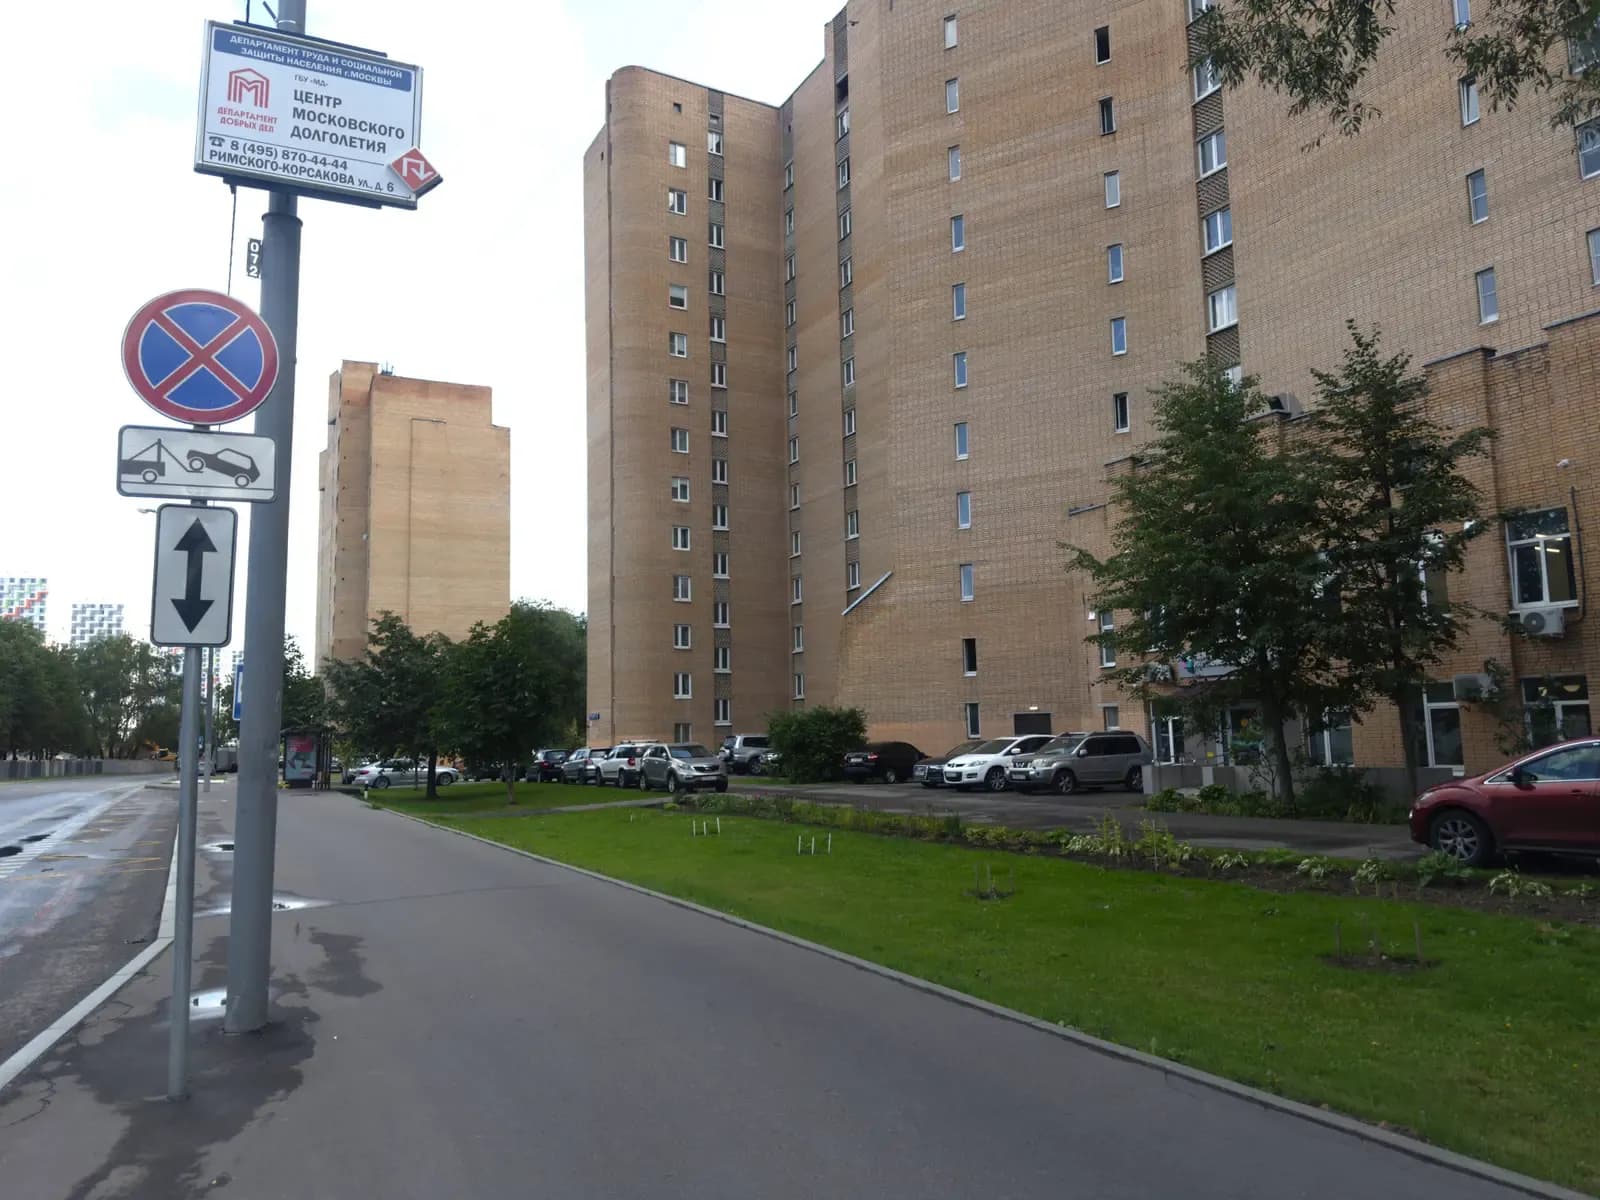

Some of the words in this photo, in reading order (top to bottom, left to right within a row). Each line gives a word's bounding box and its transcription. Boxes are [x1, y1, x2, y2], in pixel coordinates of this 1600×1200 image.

[230, 35, 298, 56] ДЕПАРТАМЕНТ
[302, 50, 330, 64] ТРУДА
[332, 57, 339, 65] И
[341, 58, 403, 79] СОЦИАЛЬНОЙ
[241, 47, 284, 62] ЗАЩИТЫ
[286, 56, 342, 76] НАСЕЛЕНИЯ
[293, 89, 342, 109] ЦЕНТР
[217, 106, 278, 125] ДЕПАРТАМЕНТ
[220, 116, 257, 130] ДОБРЫХ
[258, 123, 274, 133] ДЕЛ
[292, 106, 405, 140] МОСКОВСКОГО
[290, 125, 387, 154] ДОЛГОЛЕТИЯ
[209, 149, 355, 186] РИМСКОГО-КОРСАКОВА
[386, 182, 395, 192] 6
[230, 140, 239, 151] 8
[243, 142, 278, 160] (495)
[281, 149, 348, 171] 870-44-44
[249, 242, 260, 277] 072
